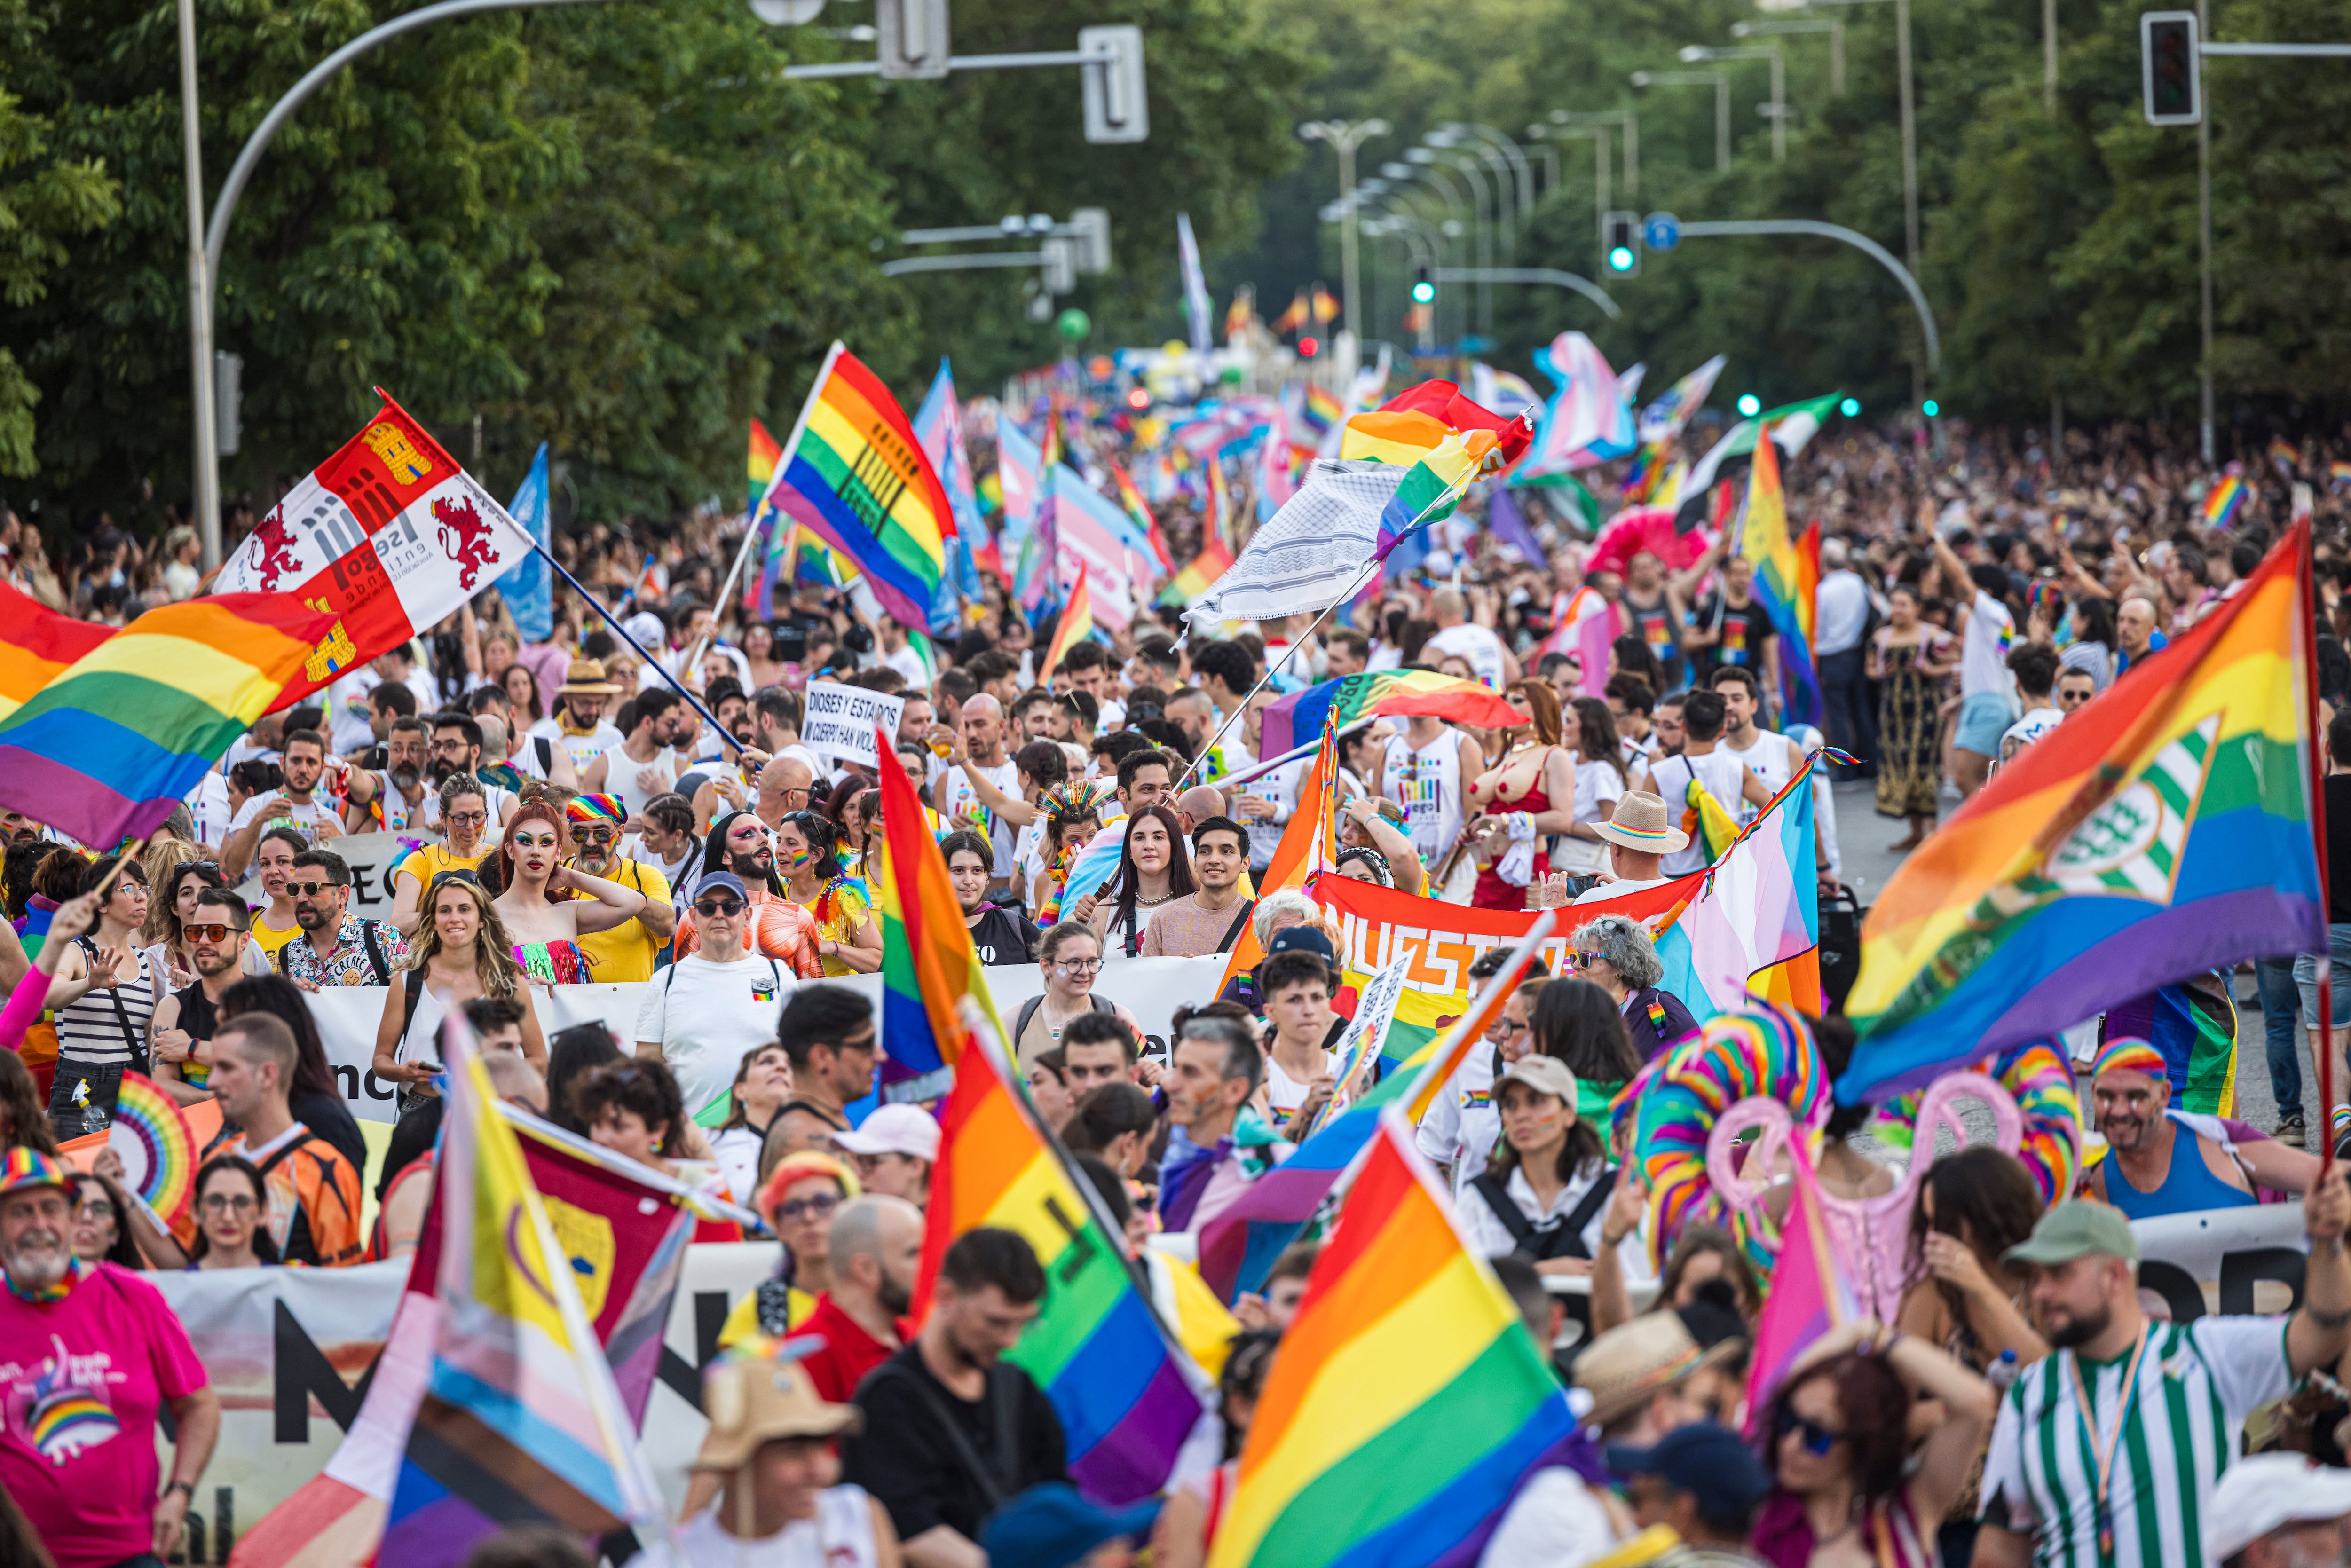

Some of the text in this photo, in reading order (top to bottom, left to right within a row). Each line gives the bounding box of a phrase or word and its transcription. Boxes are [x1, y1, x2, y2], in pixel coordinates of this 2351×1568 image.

[809, 692, 843, 713] DIOSES
[843, 695, 852, 714] Y
[837, 724, 855, 747] HAN
